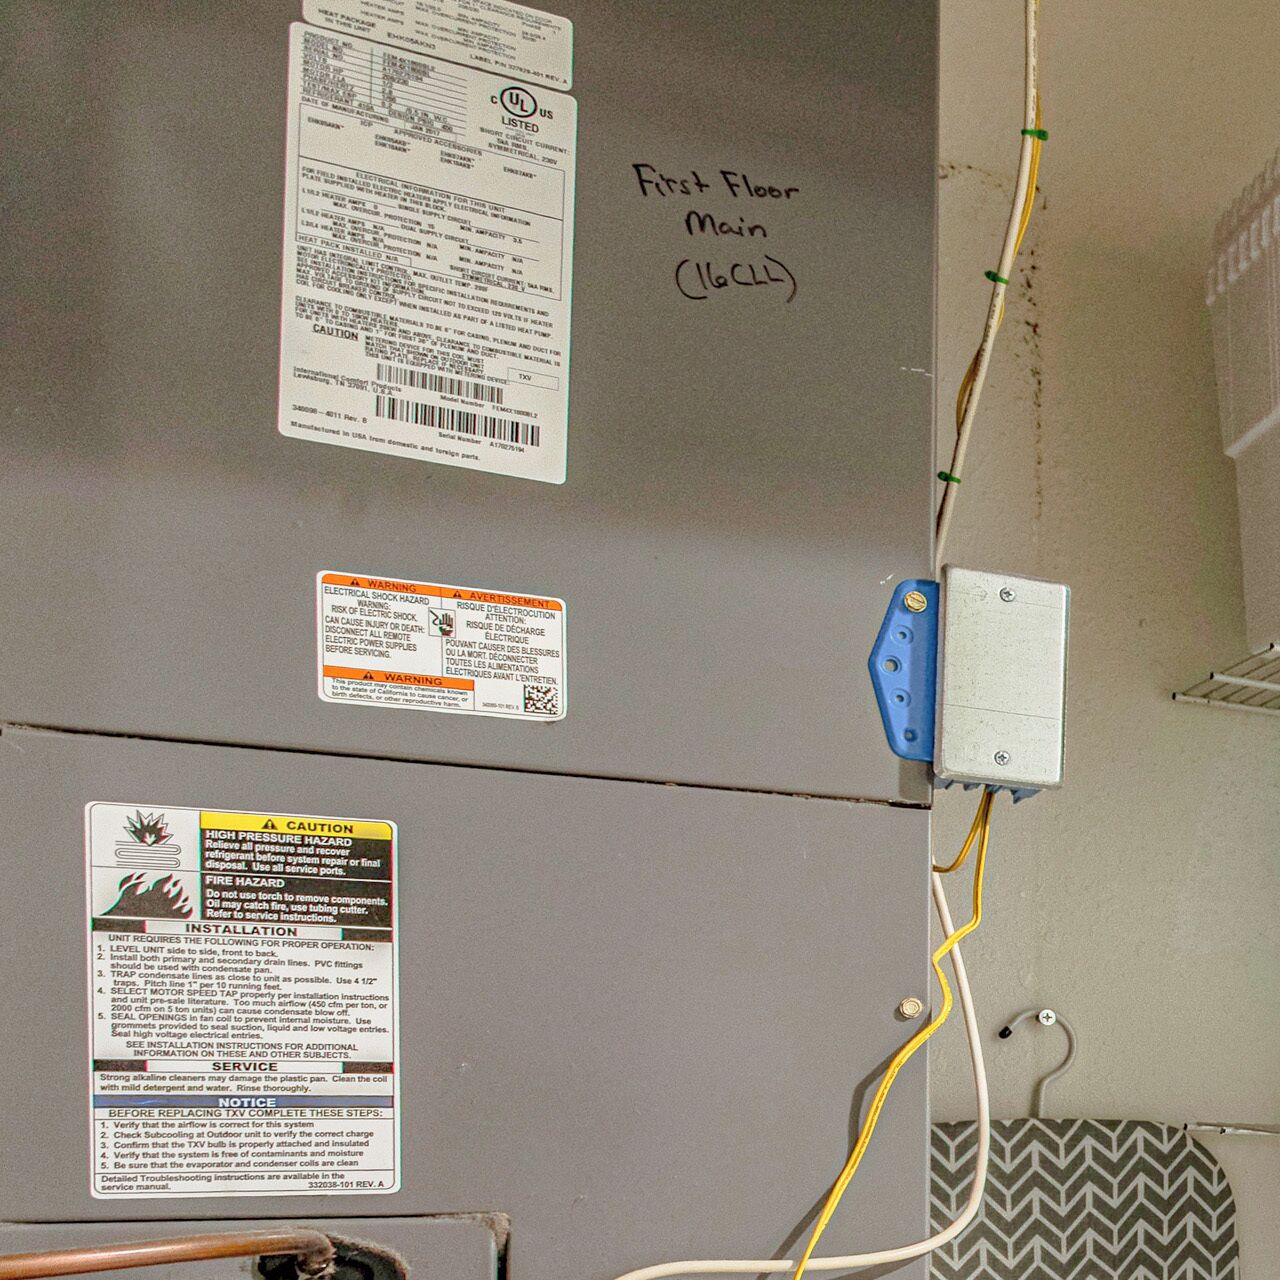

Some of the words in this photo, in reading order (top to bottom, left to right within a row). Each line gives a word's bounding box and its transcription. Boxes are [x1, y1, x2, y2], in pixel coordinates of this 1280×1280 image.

[508, 91, 529, 113] UL
[539, 109, 554, 120] US
[501, 116, 539, 134] LISTED
[632, 163, 710, 197] First
[719, 170, 799, 199] Floor
[684, 210, 767, 238] Main
[312, 324, 359, 341] CAUTION
[518, 372, 532, 382] TXV
[368, 579, 416, 593] WARNING
[324, 586, 370, 599] ELECTRICAL
[372, 591, 398, 602] SHOCK
[399, 595, 430, 605] HAZARD
[470, 592, 550, 609] AVERTISSEMENT
[331, 604, 348, 614] RISK
[348, 606, 358, 615] OF
[359, 608, 392, 619] ELECTRIC
[357, 600, 391, 610] WARNING:
[457, 601, 485, 612] RISQUE
[486, 603, 556, 620] D'ÉLECTROCUTION
[384, 673, 442, 686] WARNING
[286, 821, 353, 834] CAUTION
[205, 830, 236, 840] HIGH
[238, 832, 302, 844] PRESSURE
[304, 836, 352, 847] HAZARD
[205, 875, 233, 885] FIRE
[235, 877, 285, 887] HAZARD
[186, 923, 297, 936] INSTALLATION
[212, 1062, 277, 1071] SERVICE
[218, 1098, 276, 1107] NOTICE
[108, 1109, 155, 1117] BEFORE
[158, 1109, 222, 1117] REPLACING
[225, 1109, 246, 1117] TXV
[248, 1109, 307, 1117] COMPLETE
[309, 1109, 344, 1117] THESE
[346, 1109, 383, 1117] STEPS:
